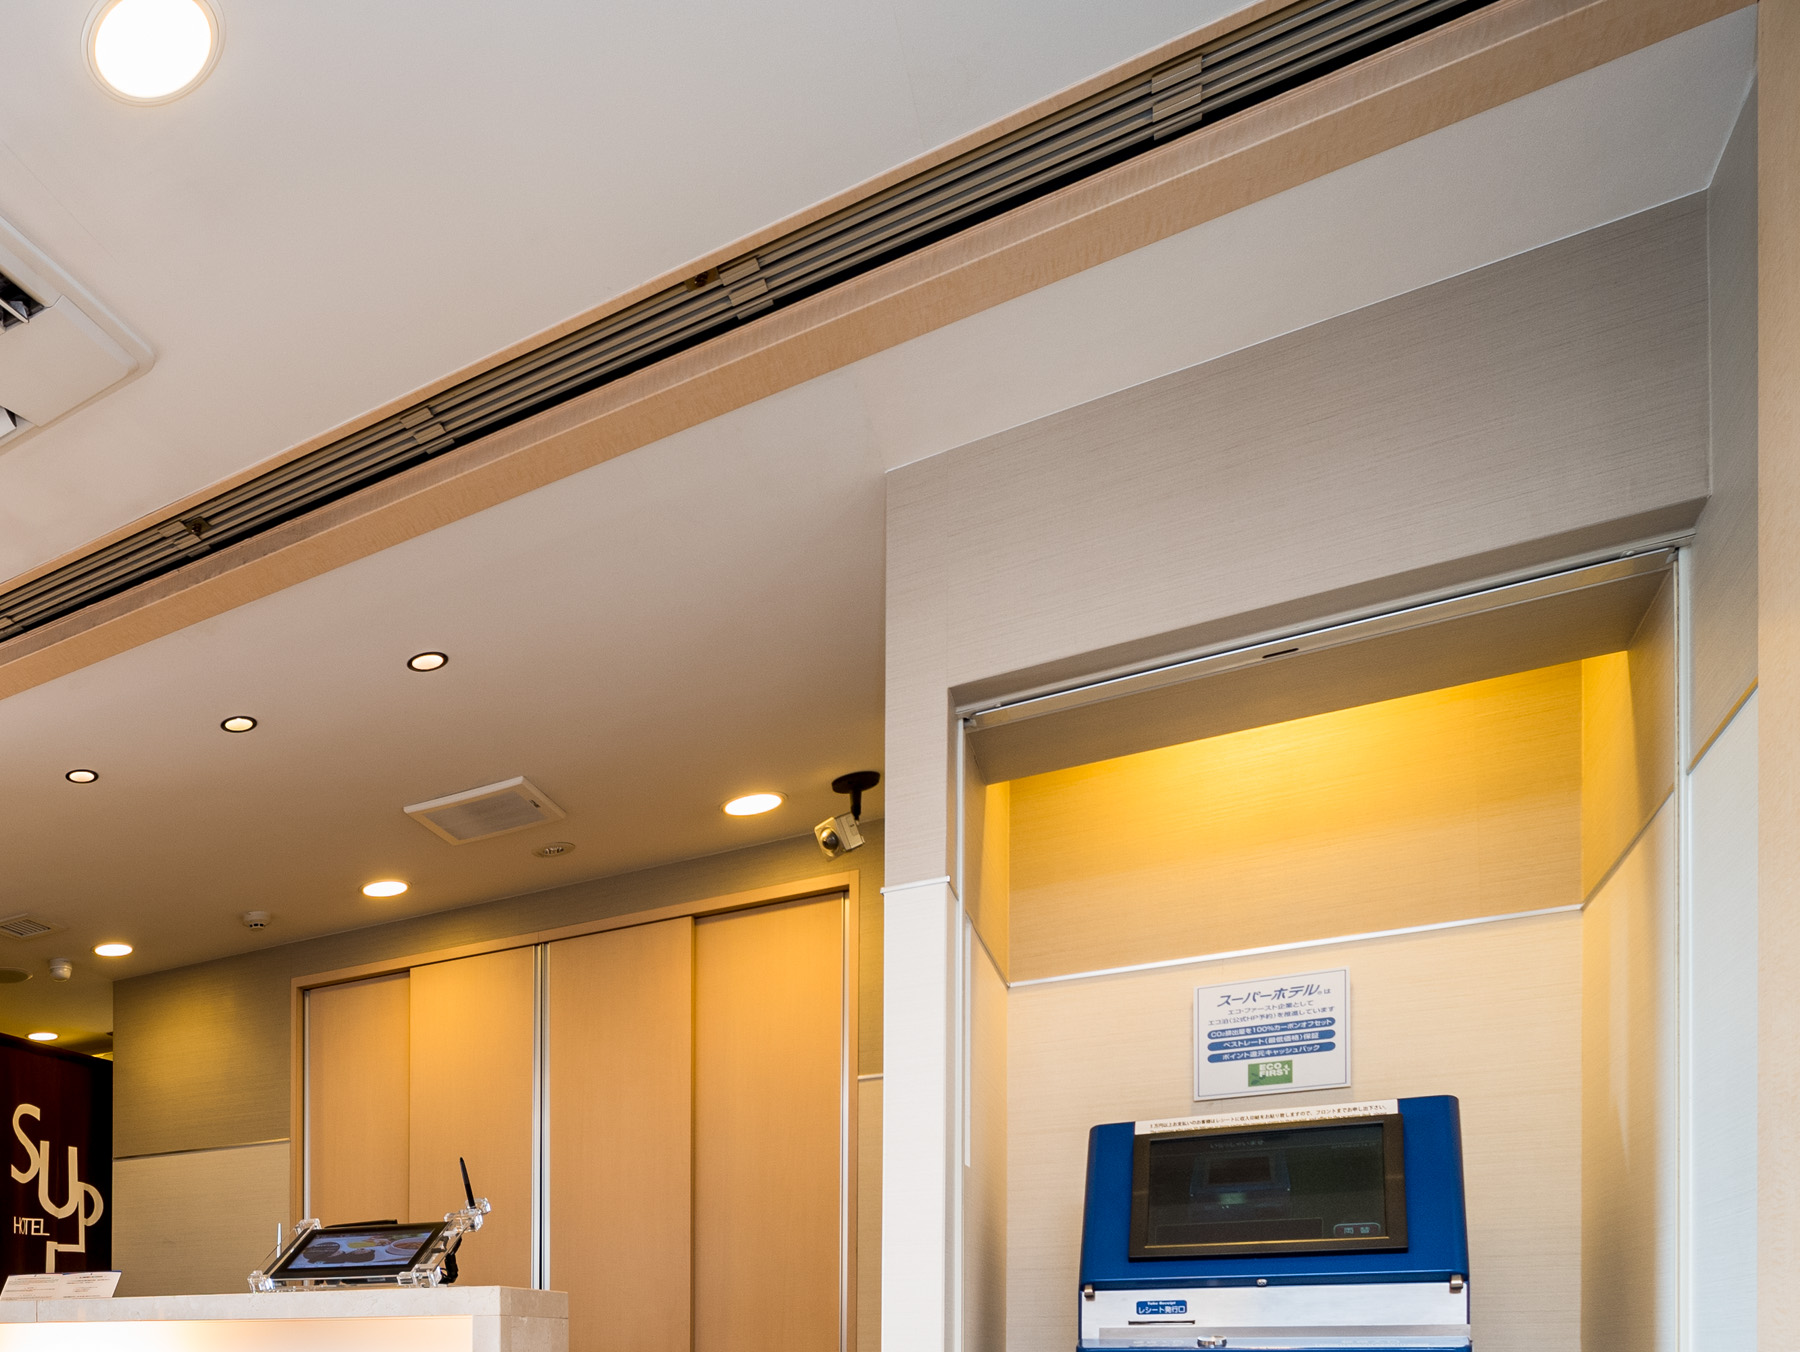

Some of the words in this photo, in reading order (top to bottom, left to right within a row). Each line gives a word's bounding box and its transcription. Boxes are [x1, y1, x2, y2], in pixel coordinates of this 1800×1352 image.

[1259, 1062, 1282, 1070] ECO
[1259, 1068, 1290, 1077] FIRST
[13, 1216, 50, 1236] HOTEL
[1138, 1305, 1186, 1314] レシート発行口
